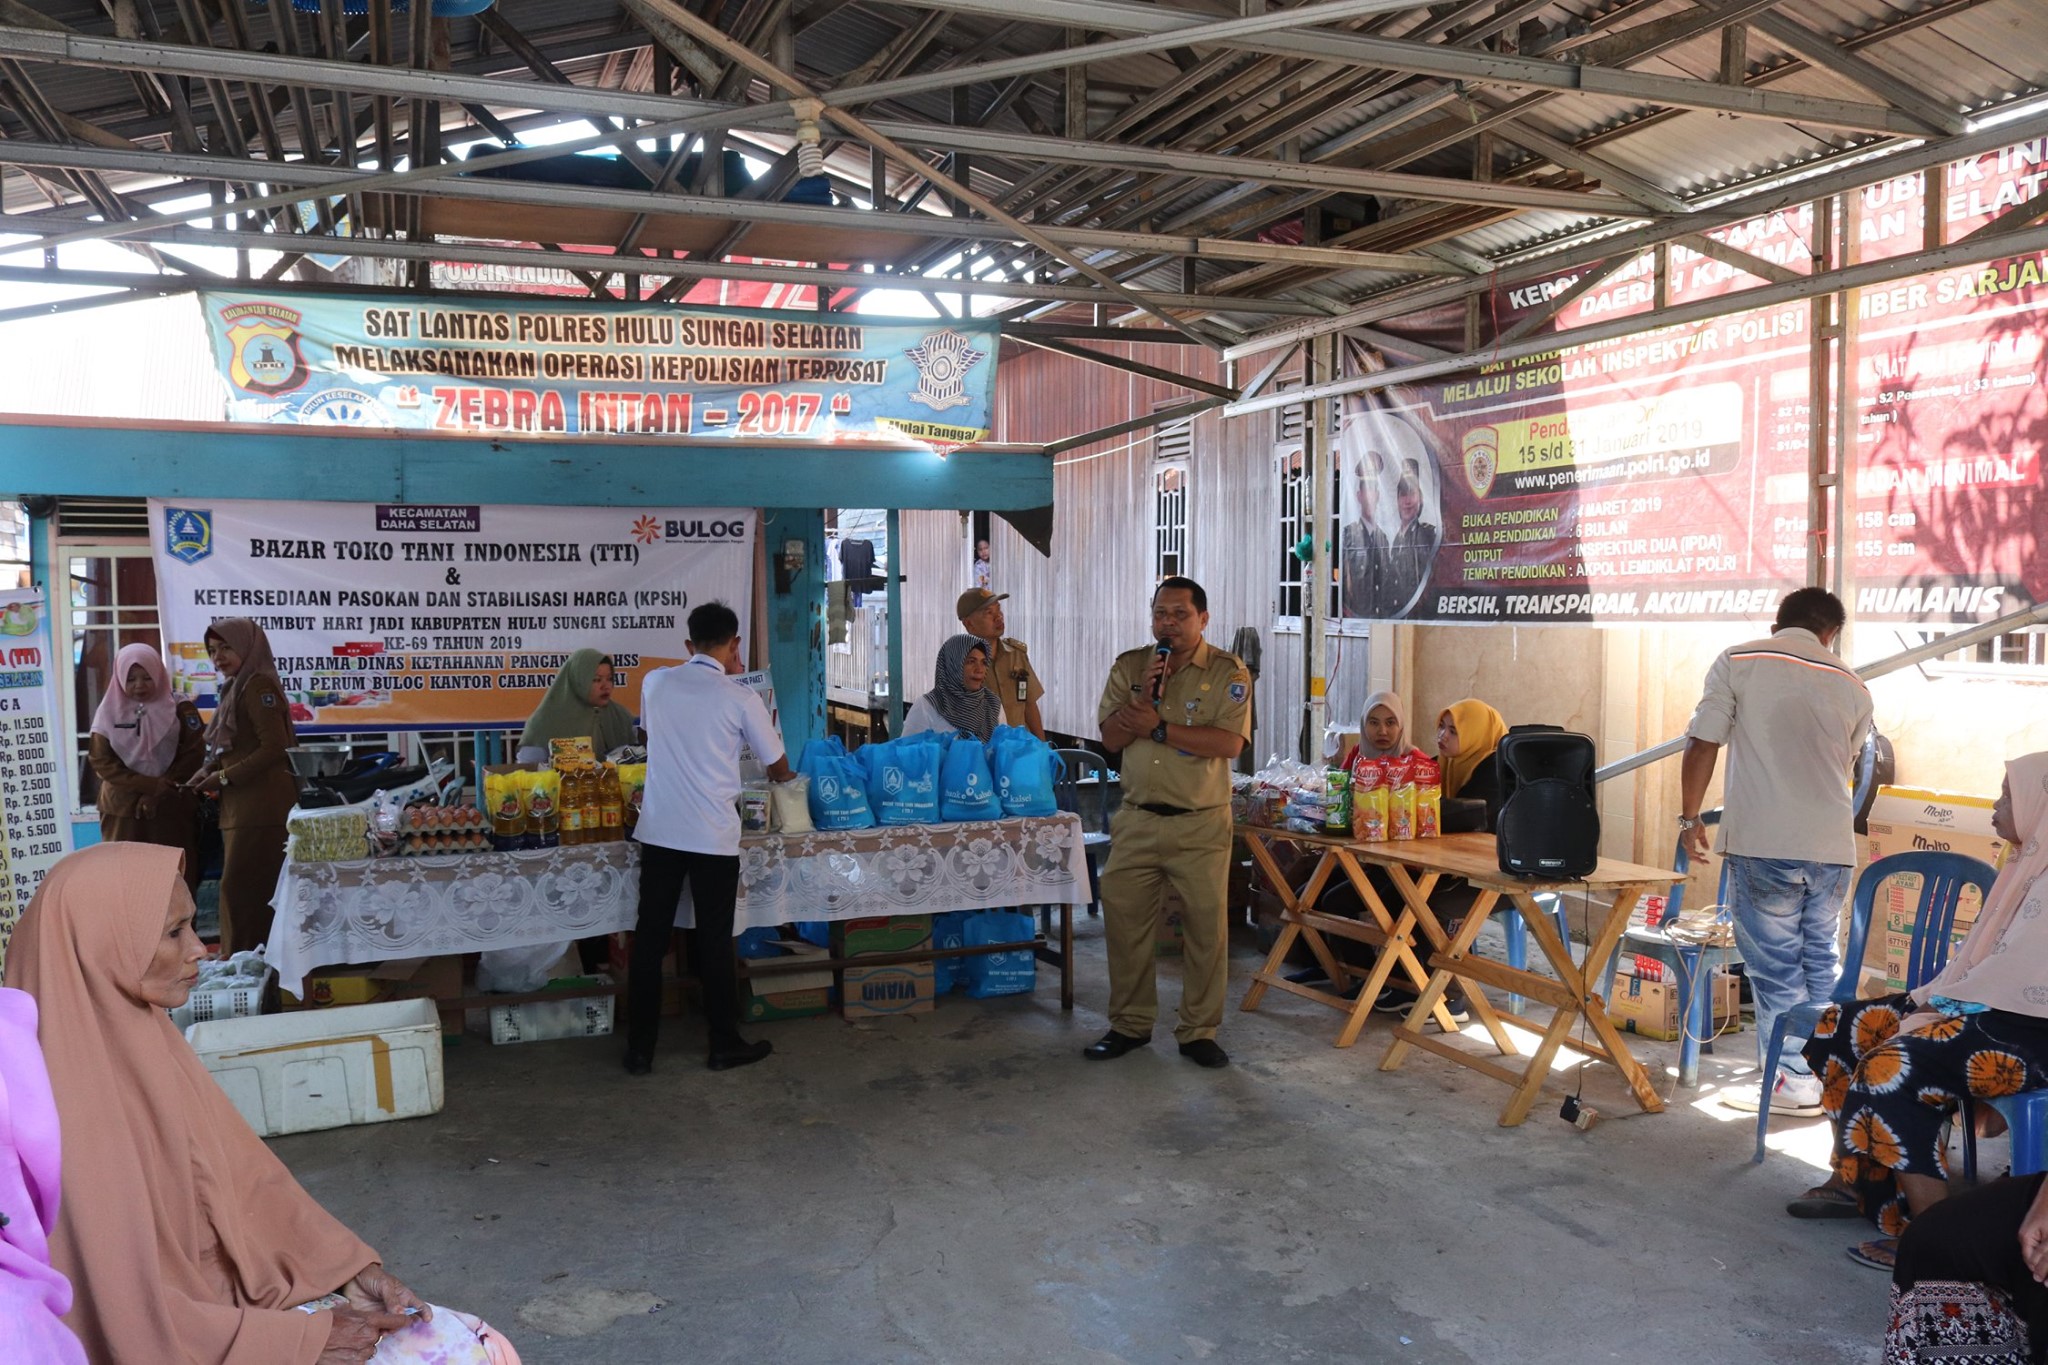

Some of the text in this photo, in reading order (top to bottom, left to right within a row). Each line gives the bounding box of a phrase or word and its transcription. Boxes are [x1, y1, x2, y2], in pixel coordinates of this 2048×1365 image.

[1936, 257, 2048, 304] SARJA
[366, 308, 863, 350] SAT LANTAS POLRES HULU SUNGAI SELATAN
[335, 344, 886, 384] MELAKSANAKAN OPERASI KEPOLISIAN TERPUSAT
[1443, 374, 1511, 404] MELALUI
[1515, 362, 1597, 395] SEKOLAH
[1602, 334, 1719, 374] INSPEKTUR
[1726, 308, 1805, 348] POLISI
[1879, 391, 1894, 404] S2
[433, 389, 566, 432] ZEBRA
[581, 390, 693, 435] INTAN
[738, 393, 821, 435] 2017
[1518, 445, 1536, 465] 15
[1540, 442, 1563, 462] s/d
[1657, 418, 1703, 444] 2019
[1923, 458, 2025, 488] MINIMAL
[389, 508, 468, 519] KECAMATAN
[1462, 513, 1492, 528] BUKA
[1494, 507, 1559, 526] PENDIDIKAN
[1584, 499, 1627, 517] MARET
[1631, 496, 1662, 514] 2019
[1856, 511, 1884, 528] 158
[1888, 512, 1916, 527] cm
[380, 519, 476, 531] DAHA SELATAN
[665, 520, 745, 538] BULOG
[1462, 519, 1629, 545] LAMA PENDIDIKAN 6 BULAN
[250, 538, 640, 567] BAZAR TOKO TANI INDONESIA (TTI)
[1463, 533, 1723, 563] OUTPUT INSPEKTUR DUA (IPDA)
[1855, 541, 1916, 557] 155 cm
[445, 567, 461, 586] &
[1463, 554, 1737, 581] TEMPAT PENDIDIKAN AKPOL LEMDIKLAT POLRI
[194, 589, 688, 609] KETERSEDIAAN PASOKAN DAN STABILISASI HARGA (KPSH)
[1437, 593, 1501, 616] BERSIH,
[1505, 591, 1640, 617] TRANSPARAN,
[1856, 586, 2005, 614] HUMANIS
[323, 616, 363, 630] HARI
[369, 616, 405, 634] JADI
[411, 616, 501, 631] KABUPATEN
[507, 616, 547, 630] HULU
[553, 616, 606, 630] SUNGAI
[612, 615, 675, 630] SELATAN
[384, 636, 522, 651] KE-69 TAHUN 2019
[357, 655, 405, 671] DINAS
[411, 655, 505, 670] KETAHANAN
[310, 676, 366, 691] PERUM
[372, 676, 424, 691] BULOG
[430, 674, 492, 690] KANTOR
[14, 717, 44, 731] 11.500
[16, 732, 49, 745] 12.500
[18, 747, 45, 760] 8000
[1, 761, 57, 779] Rp. 80.000
[3, 777, 51, 794] Rp. 2.500
[5, 792, 53, 810] Rp. 2.500
[7, 807, 55, 825] Rp. 4.500
[1923, 804, 1953, 818] Molto
[9, 822, 57, 841] Rp. 5.500
[11, 847, 28, 860] Rp.
[29, 841, 62, 856] 12.500
[14, 873, 30, 886] Rp.
[1888, 963, 1900, 974] 10
